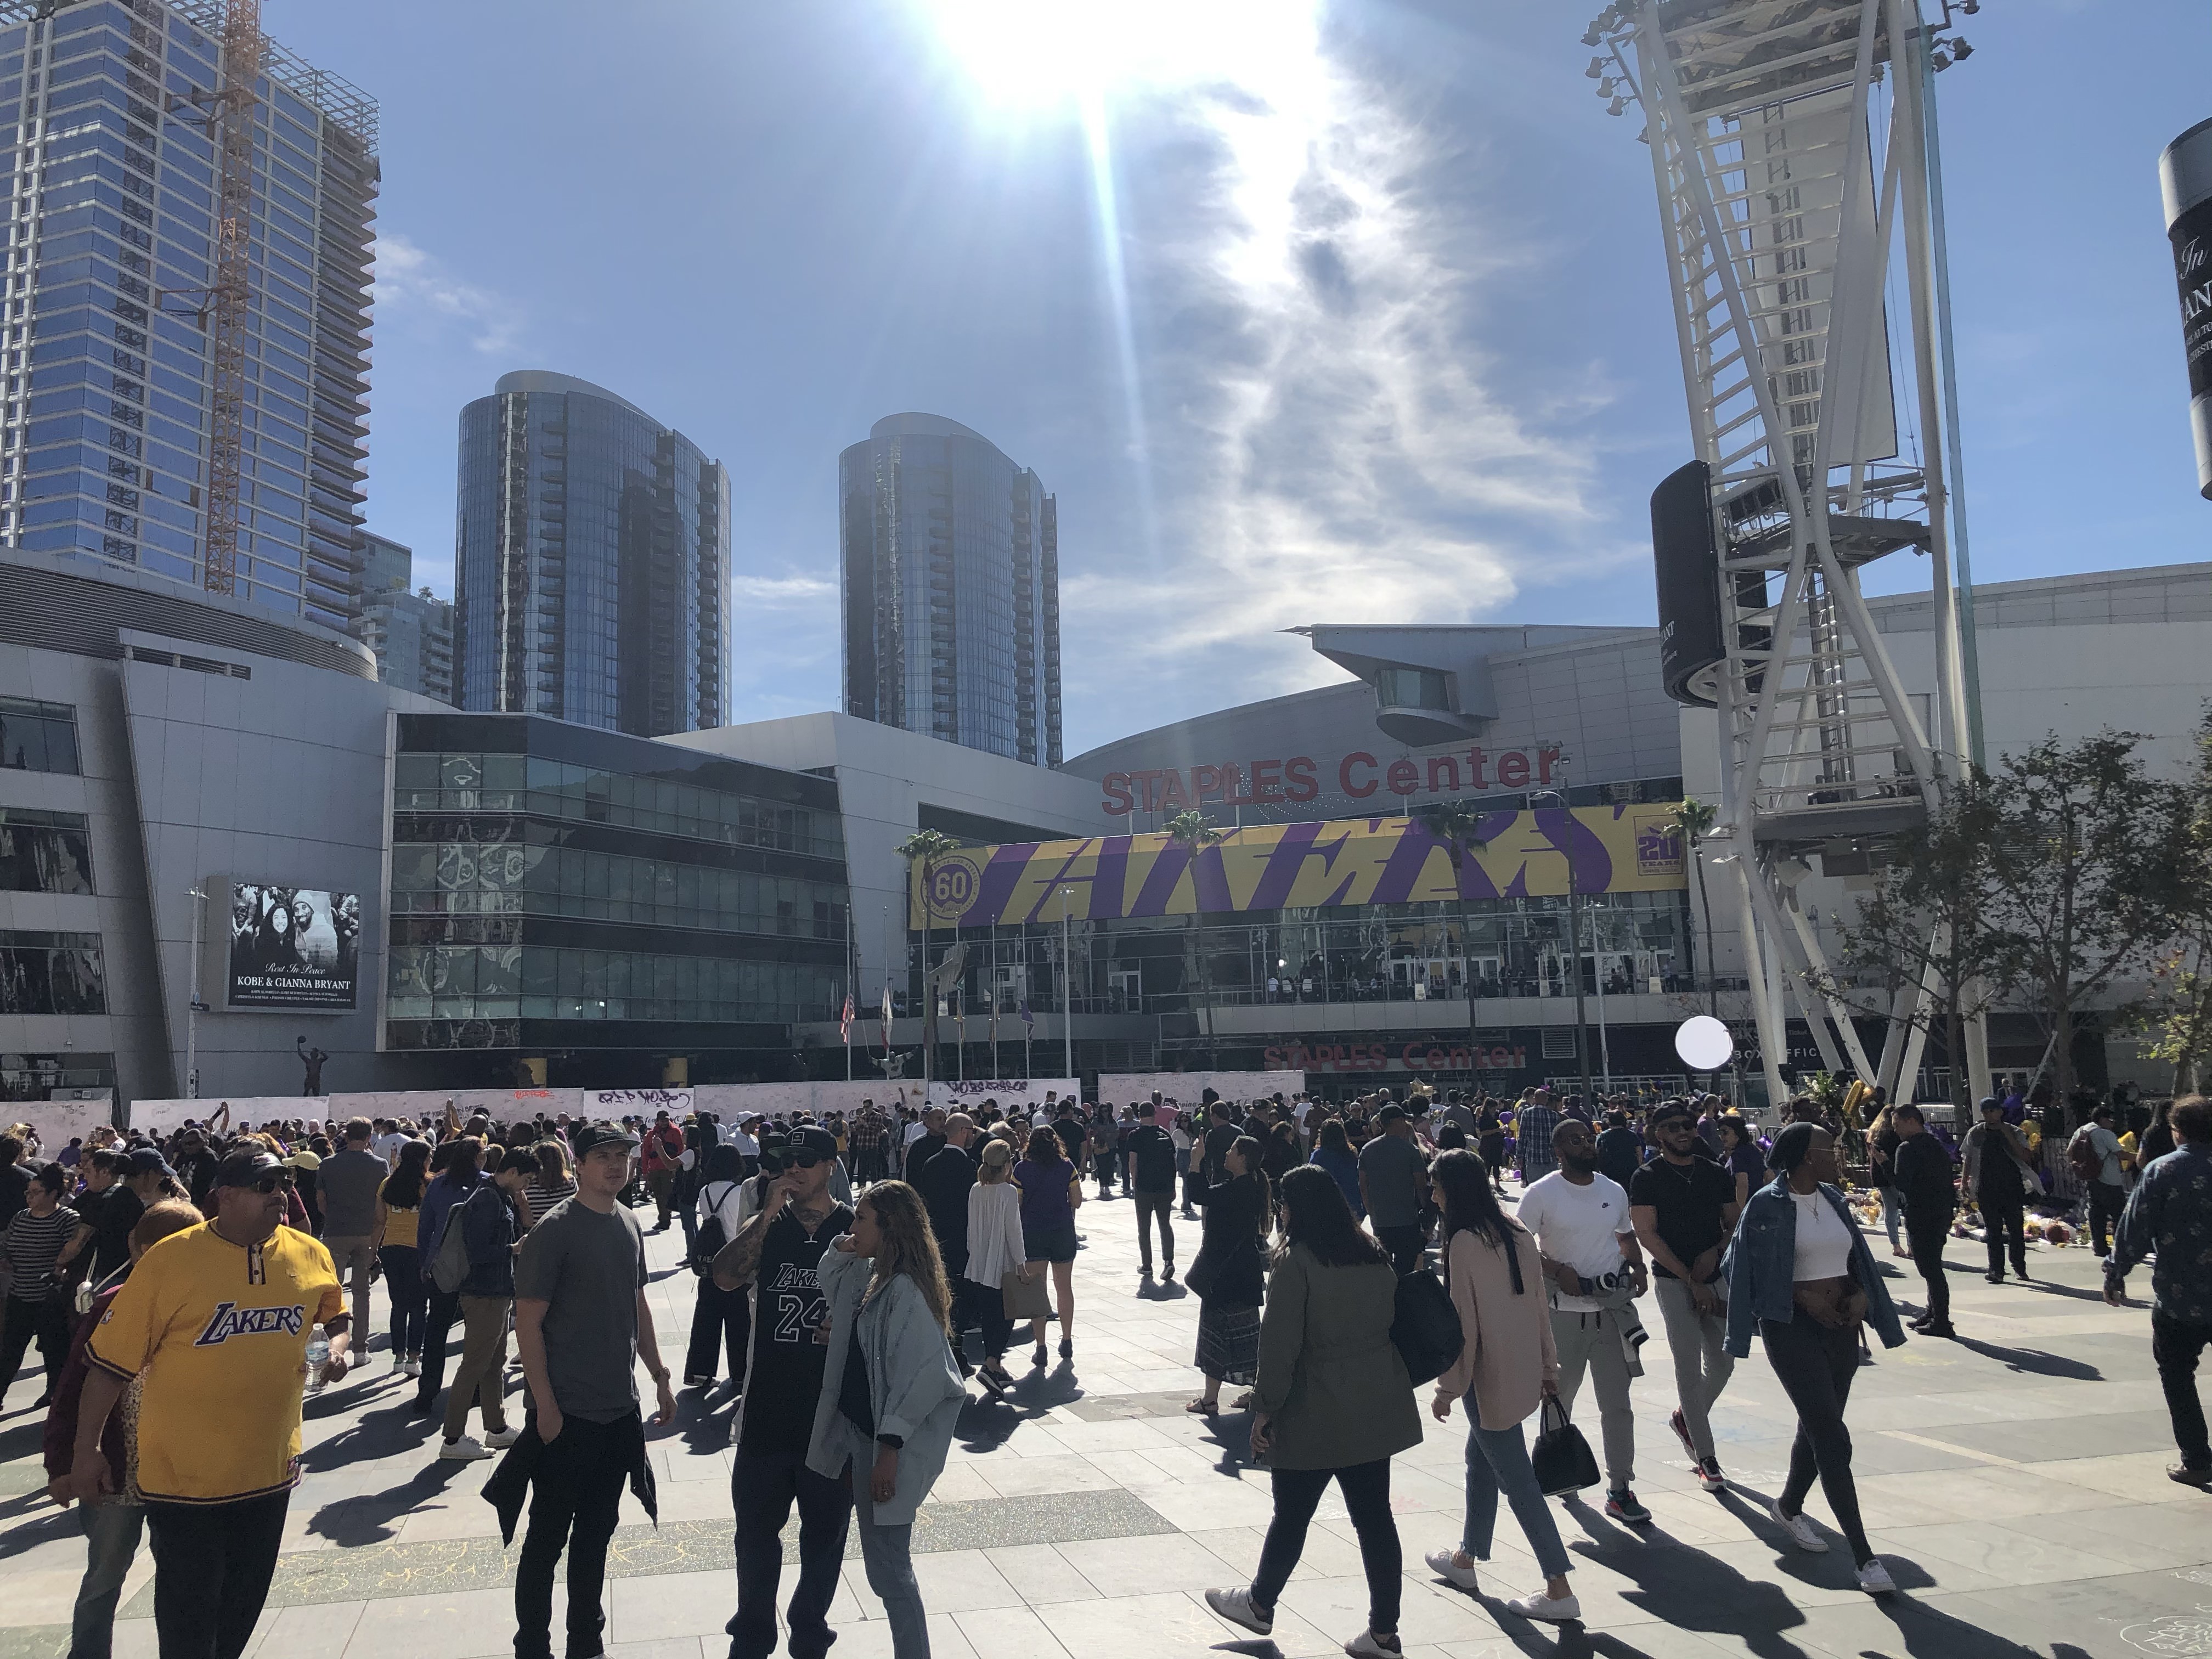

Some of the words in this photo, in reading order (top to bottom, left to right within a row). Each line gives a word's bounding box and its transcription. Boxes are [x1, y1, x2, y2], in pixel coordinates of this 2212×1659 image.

[2180, 236, 2209, 280] In
[2181, 279, 2212, 330] AN
[1101, 755, 1318, 816] STAPLES
[1339, 746, 1560, 799] Center
[1638, 836, 1680, 861] 20
[936, 872, 967, 900] 60
[238, 976, 264, 986] KOBE
[266, 977, 273, 986] &
[275, 978, 312, 988] GIANNA
[314, 979, 351, 990] BRYANT
[265, 962, 284, 973] Rest
[286, 963, 299, 973] In
[301, 964, 326, 975] Peace
[1264, 1043, 1389, 1071] STAPLES
[1402, 1042, 1526, 1070] Center
[193, 1300, 307, 1347] LAKERS
[774, 1295, 830, 1344] 24
